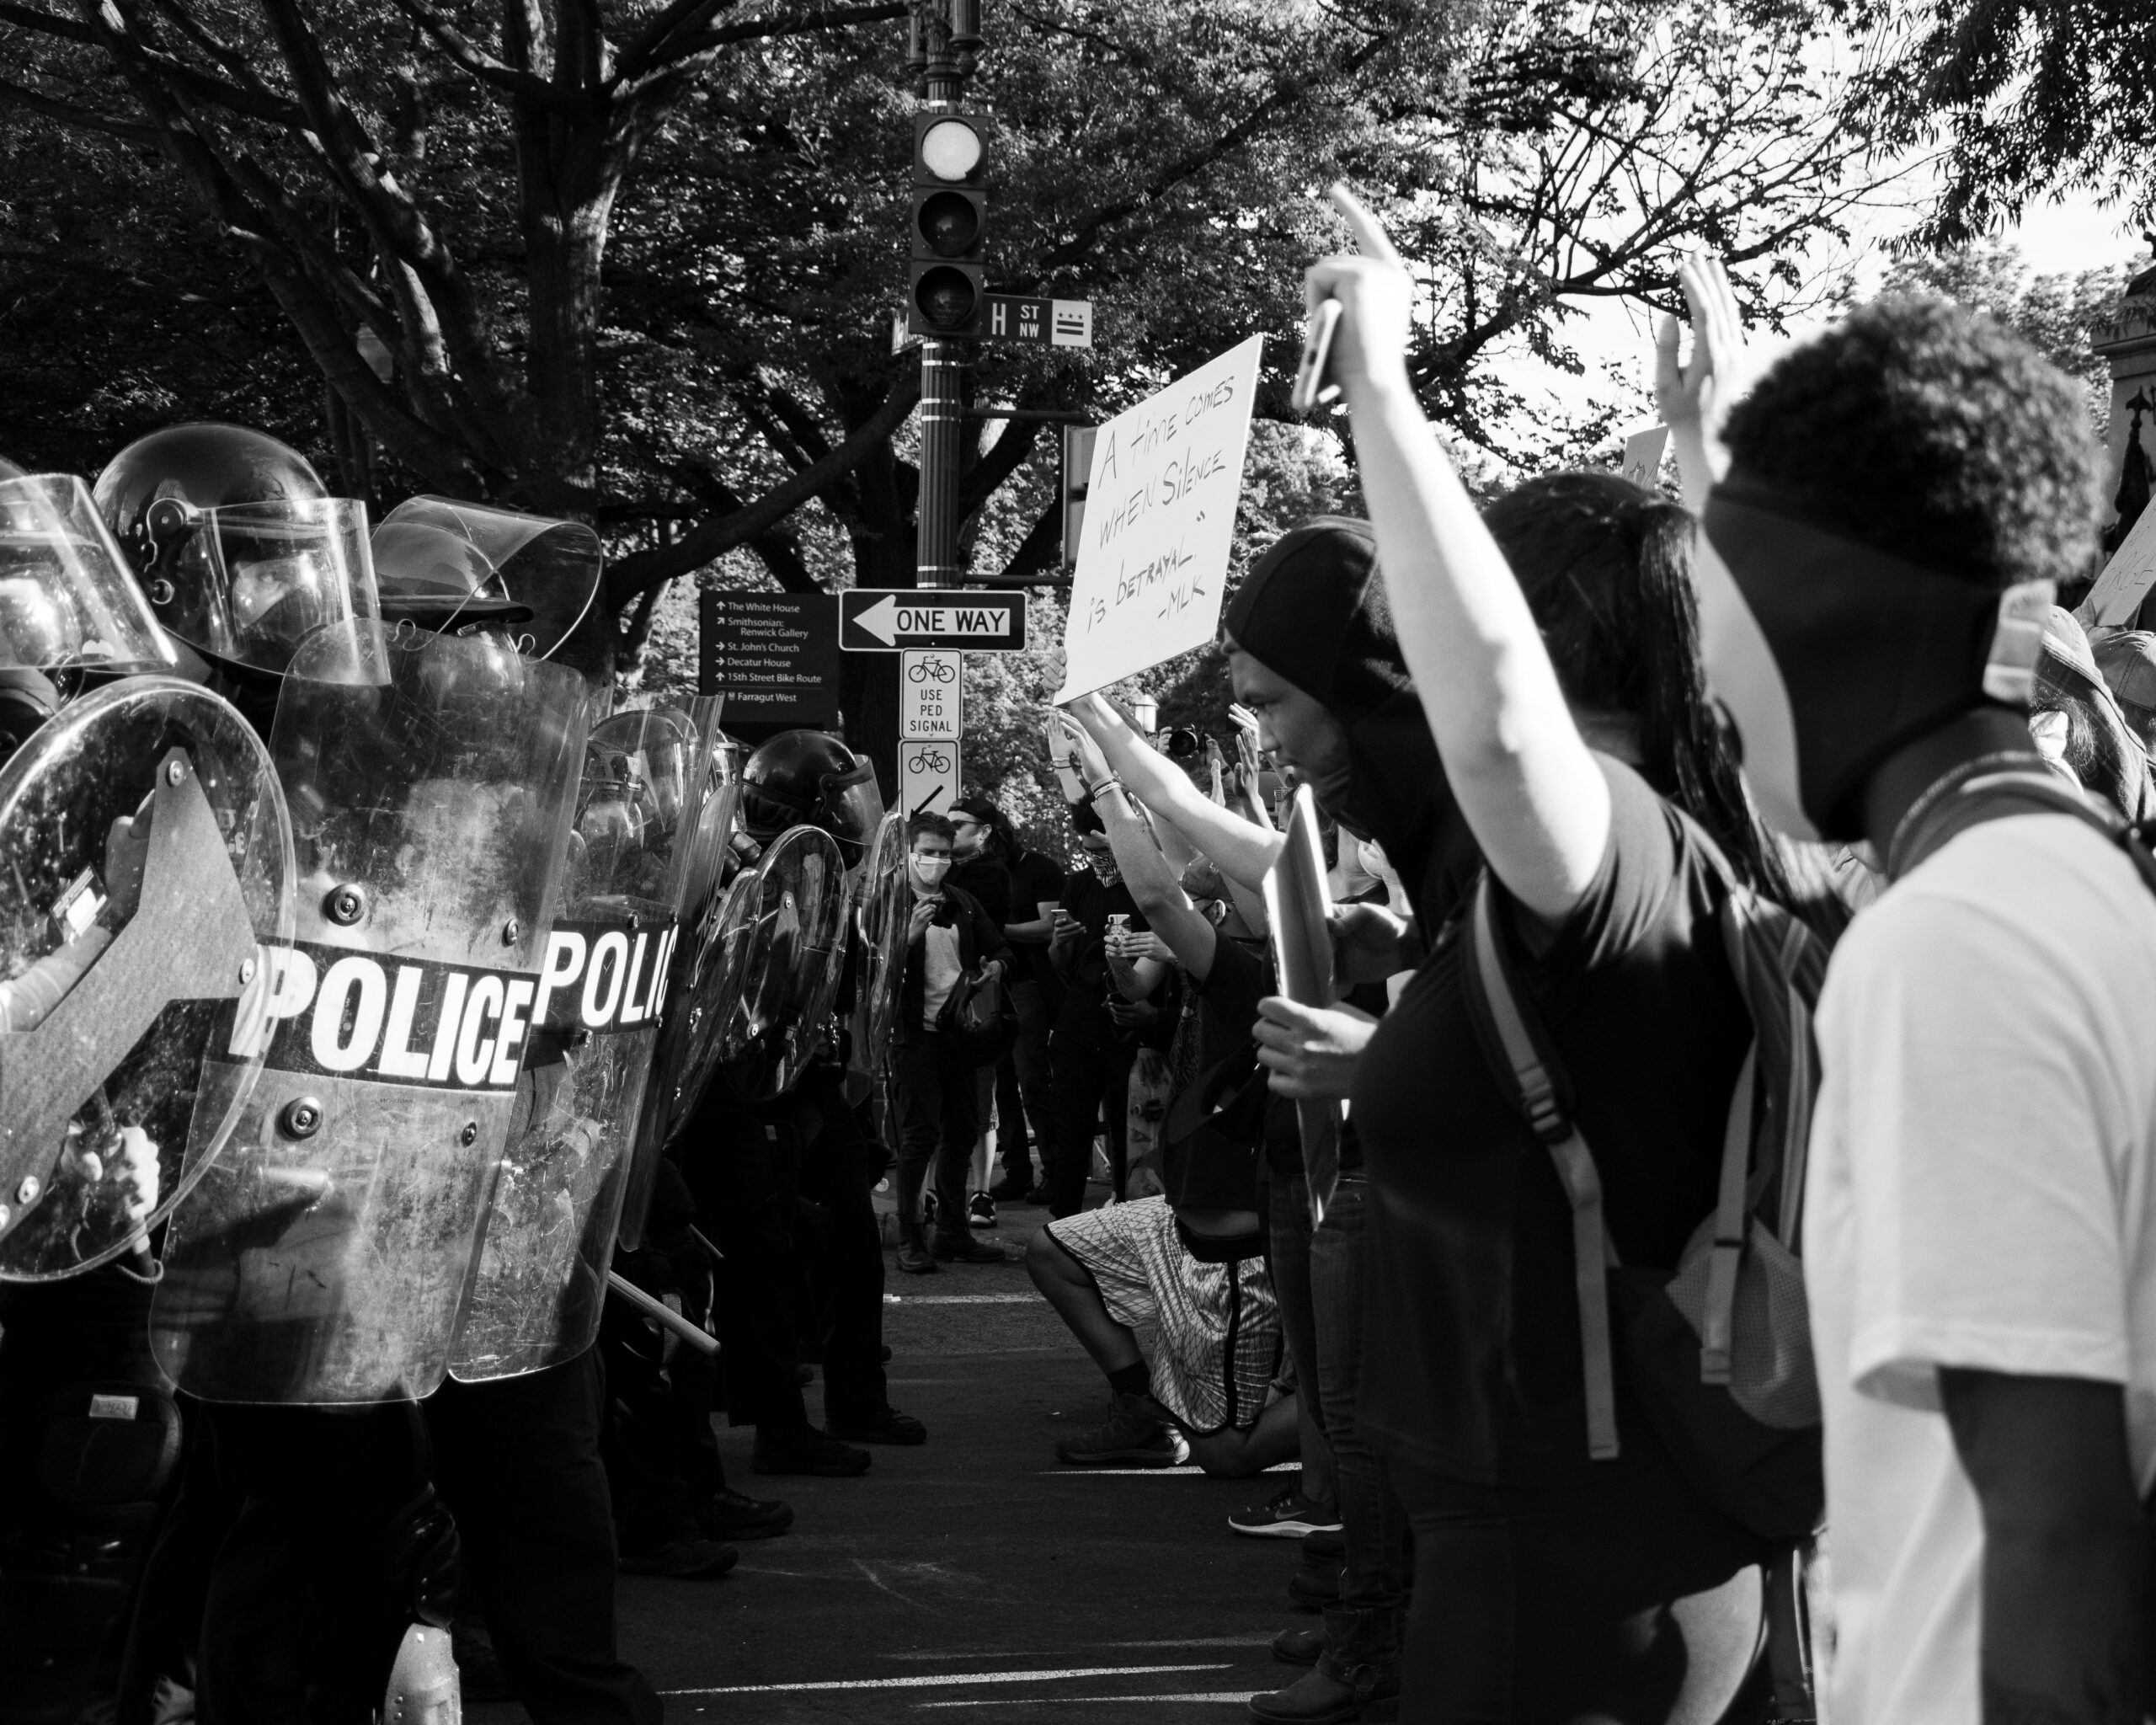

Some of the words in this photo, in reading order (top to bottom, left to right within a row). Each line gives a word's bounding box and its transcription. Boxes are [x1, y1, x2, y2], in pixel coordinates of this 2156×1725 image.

[992, 302, 1006, 335] H
[1020, 305, 1040, 319] ST
[1019, 323, 1039, 338] NW
[1098, 430, 1117, 489] A
[1100, 474, 1156, 549] WHEN
[728, 601, 744, 611] The
[745, 602, 771, 612] White
[773, 604, 800, 613] House
[728, 617, 784, 628] Smithsonian:
[897, 609, 945, 632] ONE
[955, 610, 1006, 633] WAY
[740, 627, 776, 638] Renwick
[778, 628, 808, 640] Gallery
[727, 642, 739, 651] St.
[768, 643, 800, 653] Church
[727, 657, 762, 667] Decatur
[763, 659, 792, 668] House
[728, 672, 748, 681] 15th
[749, 673, 775, 682] Street
[776, 673, 796, 683] Bike
[796, 674, 823, 684] Route
[737, 692, 774, 703] Farragut
[775, 693, 798, 702] West
[921, 689, 942, 700] USE
[920, 704, 942, 716] PED
[910, 720, 953, 732] SIGNAL
[531, 923, 679, 1027] POLIC
[228, 944, 534, 1086] POLICE
